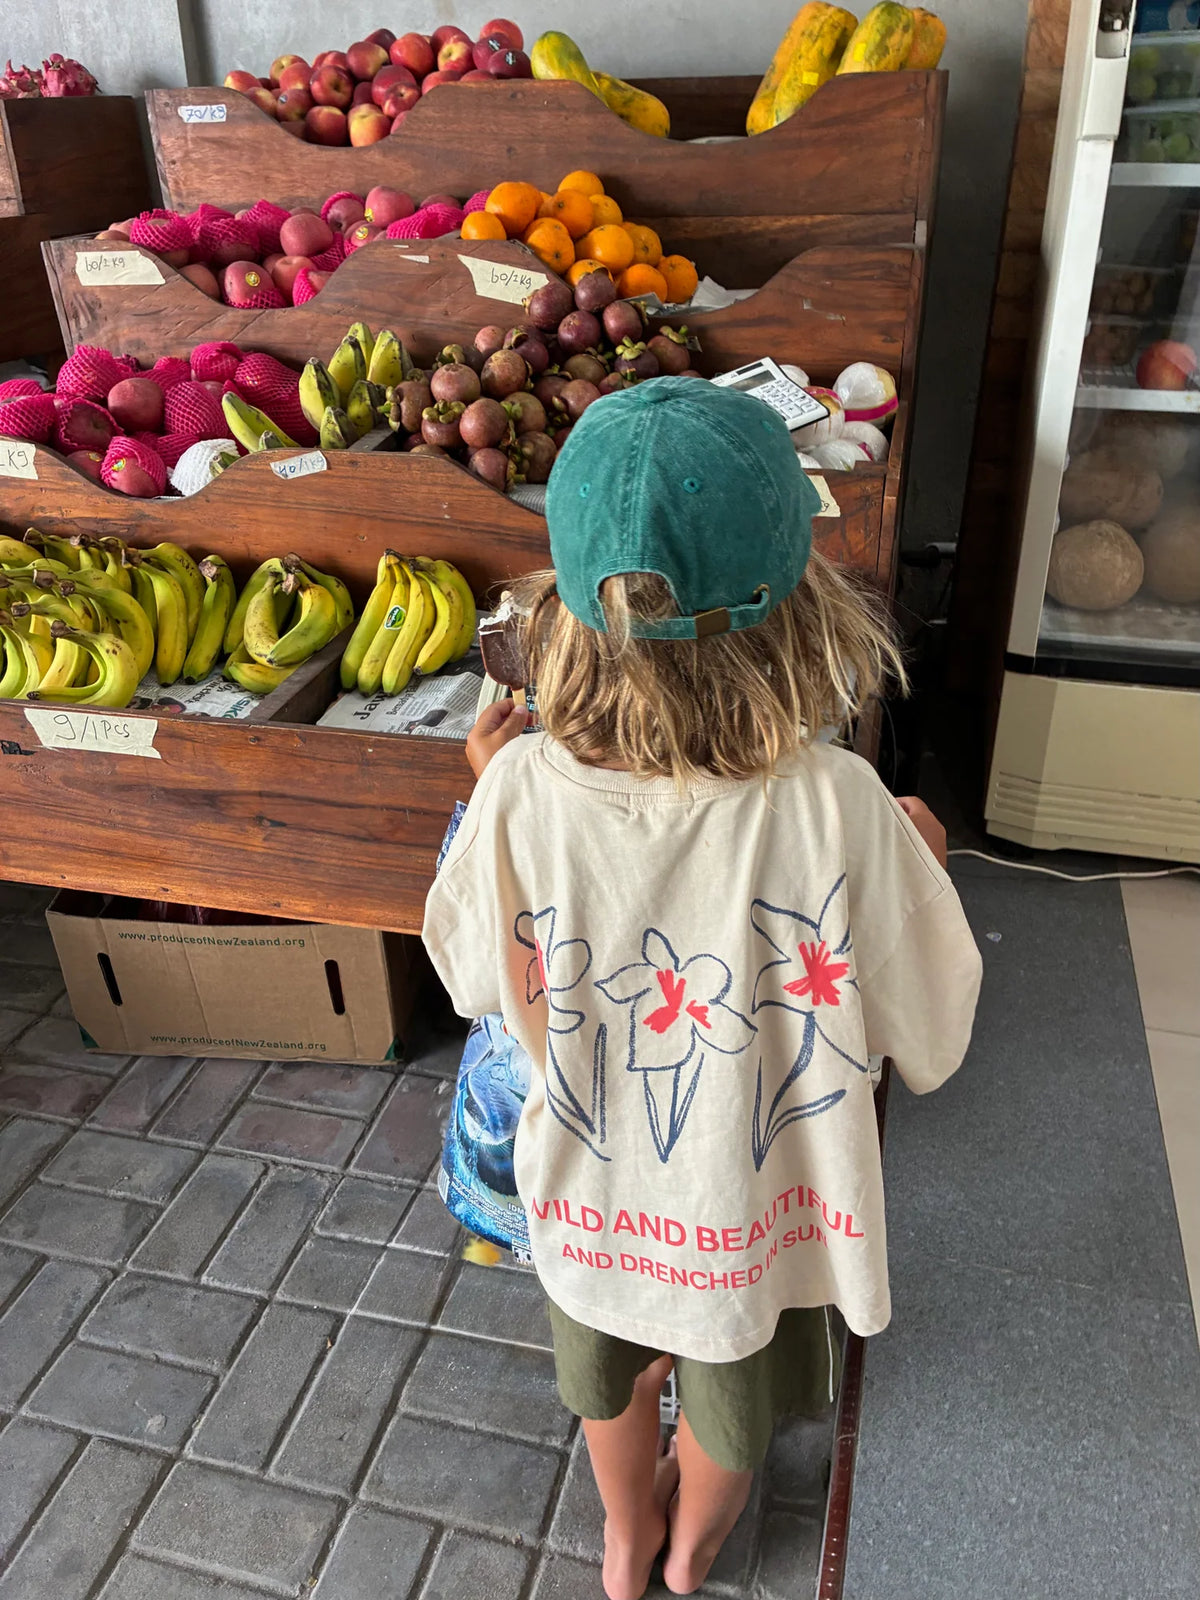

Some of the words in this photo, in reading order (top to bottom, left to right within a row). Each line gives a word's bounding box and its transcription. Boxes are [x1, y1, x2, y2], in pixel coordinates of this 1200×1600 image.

[118, 931, 305, 947] www.produceofNewZealand.org
[150, 1034, 326, 1051] www.produceofNewZealand.org
[613, 1209, 687, 1247] AND
[696, 1185, 865, 1252] BEAUTIFUL
[562, 1243, 613, 1270] AND
[620, 1253, 763, 1290] DRENCHED
[766, 1238, 778, 1270] IN
